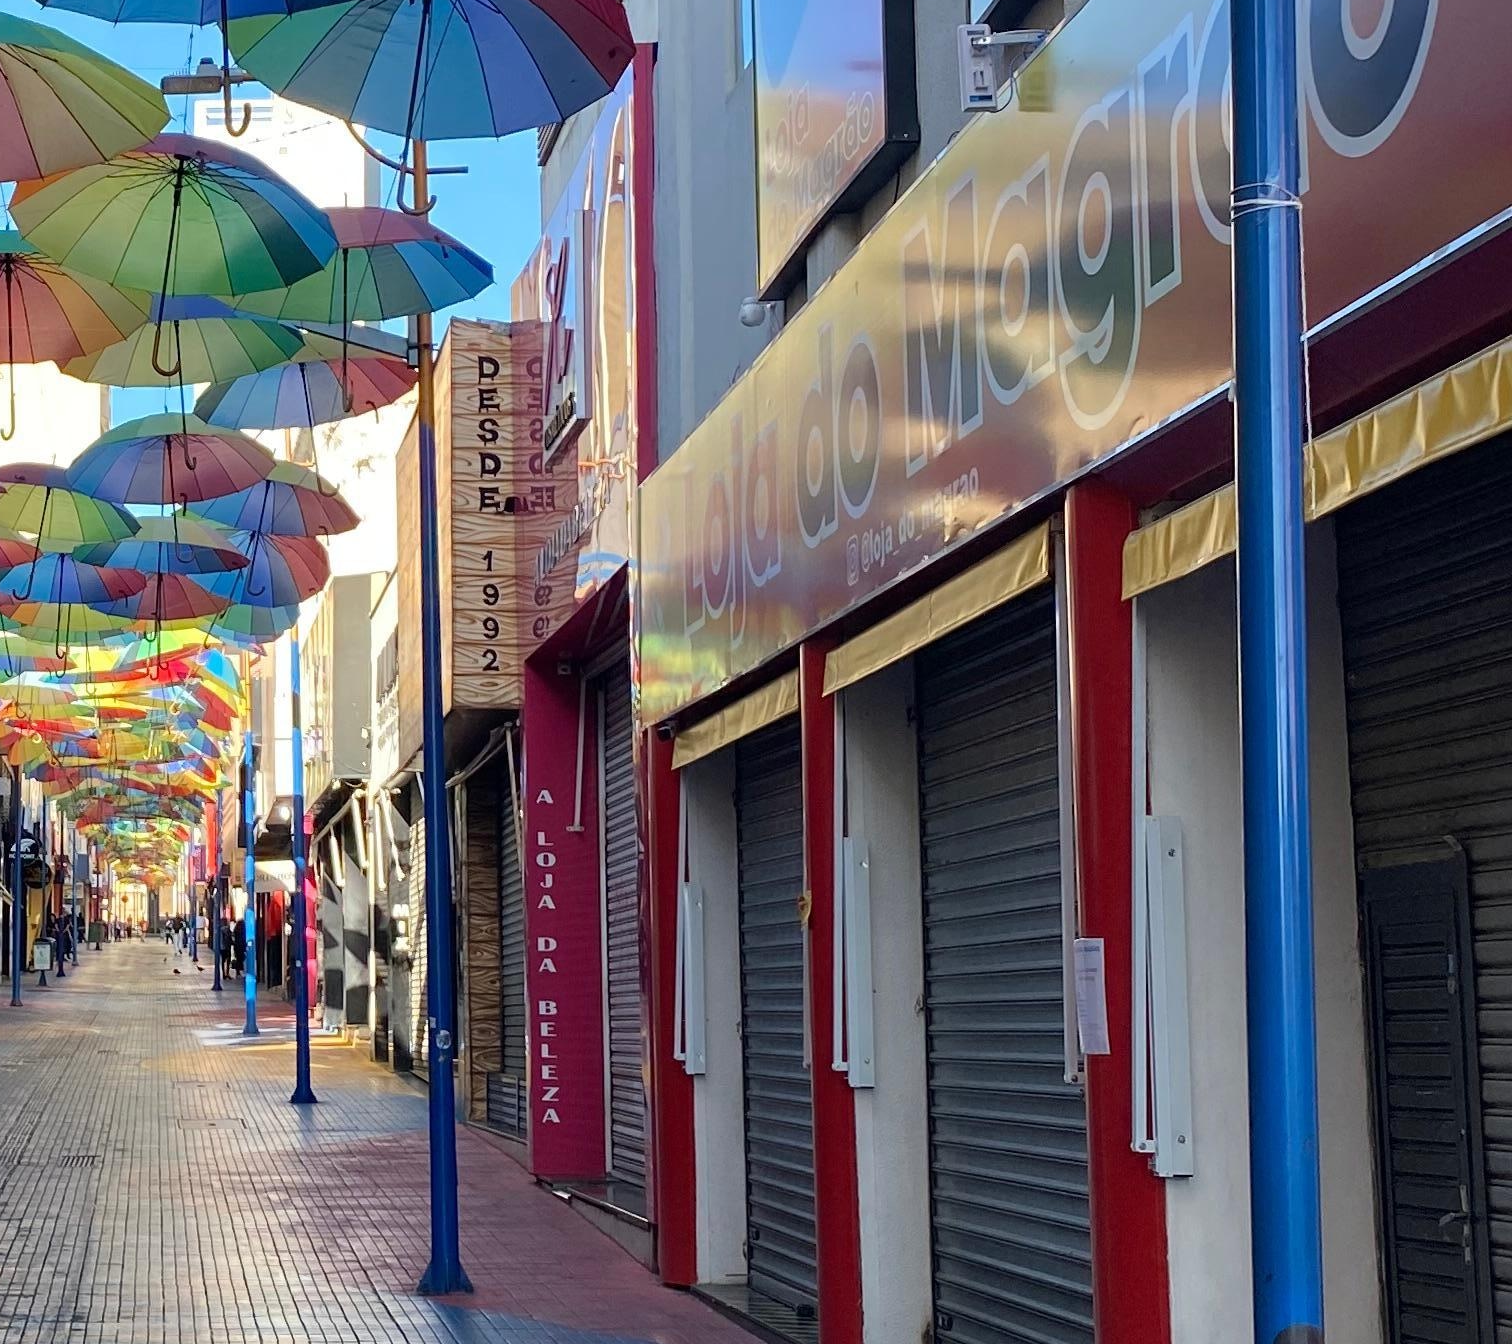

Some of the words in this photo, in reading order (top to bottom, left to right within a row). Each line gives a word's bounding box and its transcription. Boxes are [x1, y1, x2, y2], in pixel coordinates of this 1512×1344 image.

[476, 355, 502, 513] DESDE
[683, 411, 783, 650] Loja
[796, 322, 882, 549] do
[481, 549, 500, 672] 1992
[536, 789, 554, 804] A
[536, 831, 556, 910] LOJA
[537, 937, 557, 973] DA
[538, 1001, 560, 1124] BELEZA
